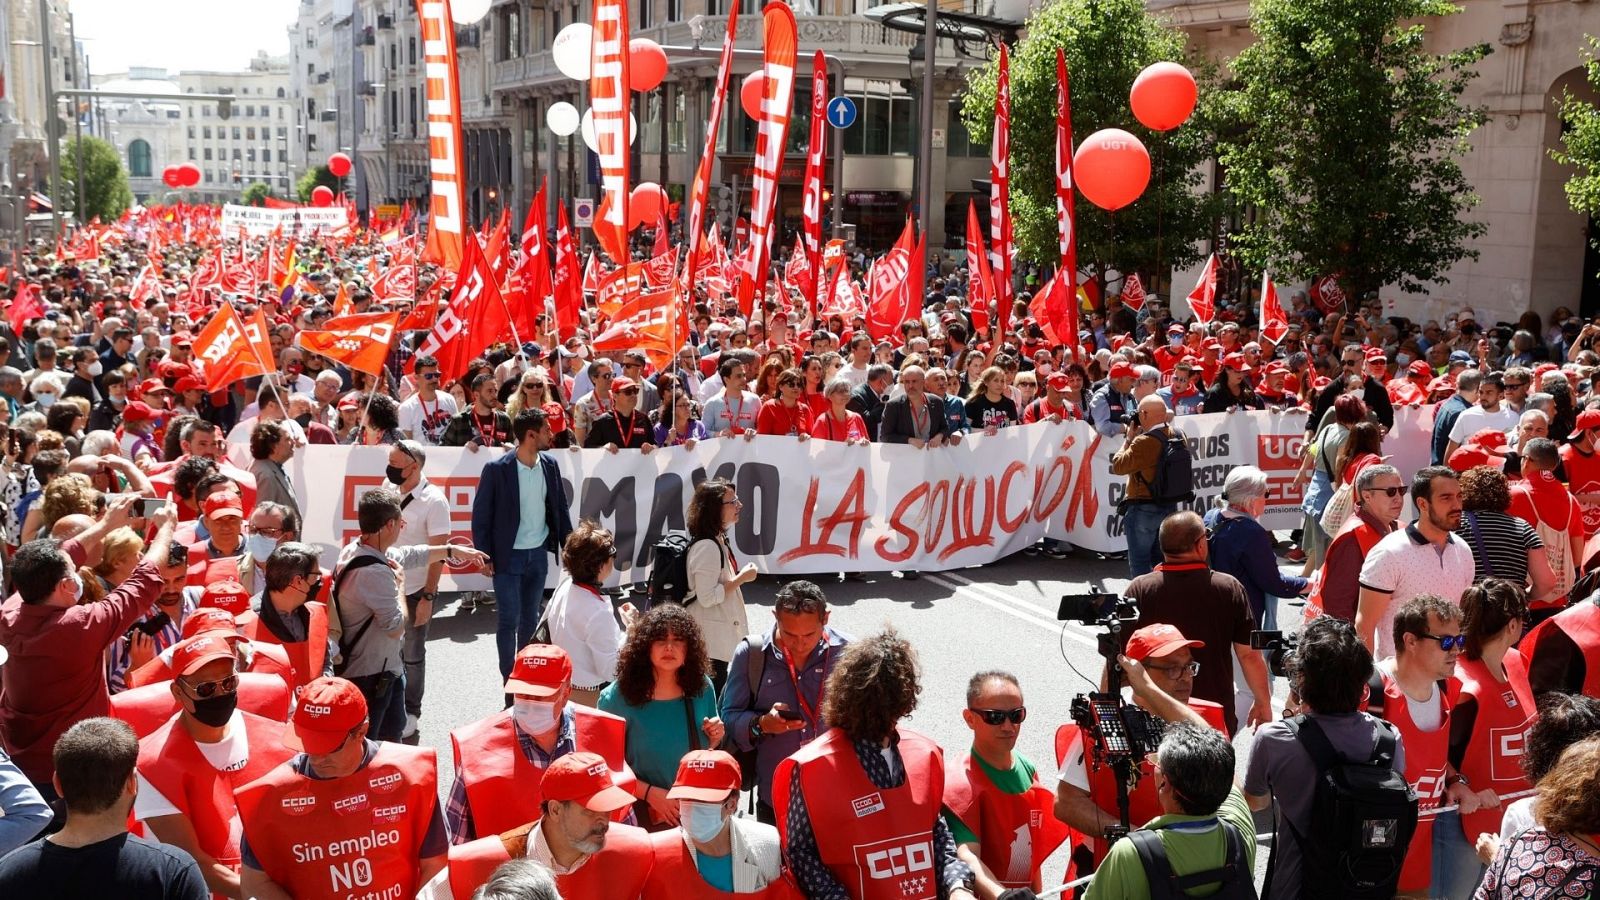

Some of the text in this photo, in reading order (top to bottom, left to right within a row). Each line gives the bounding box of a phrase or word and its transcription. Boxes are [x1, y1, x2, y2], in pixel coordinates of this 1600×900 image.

[1101, 140, 1128, 151] UGT
[1264, 438, 1303, 459] UG
[777, 466, 872, 567] LA
[873, 434, 1101, 563] SOLUCIÓN
[1264, 506, 1304, 515] omisiones
[185, 638, 213, 653] CCOO
[522, 657, 547, 666] CCOO
[304, 704, 331, 715] CCOO
[687, 760, 715, 769] CCOO
[369, 772, 402, 789] CCOO
[282, 796, 316, 808] CCOO
[334, 794, 367, 811] CCOO
[855, 798, 873, 809] CCOO
[374, 804, 407, 817] CCOO
[292, 828, 400, 865] Sin empleo
[866, 842, 933, 880] CCO
[330, 858, 374, 893] NO
